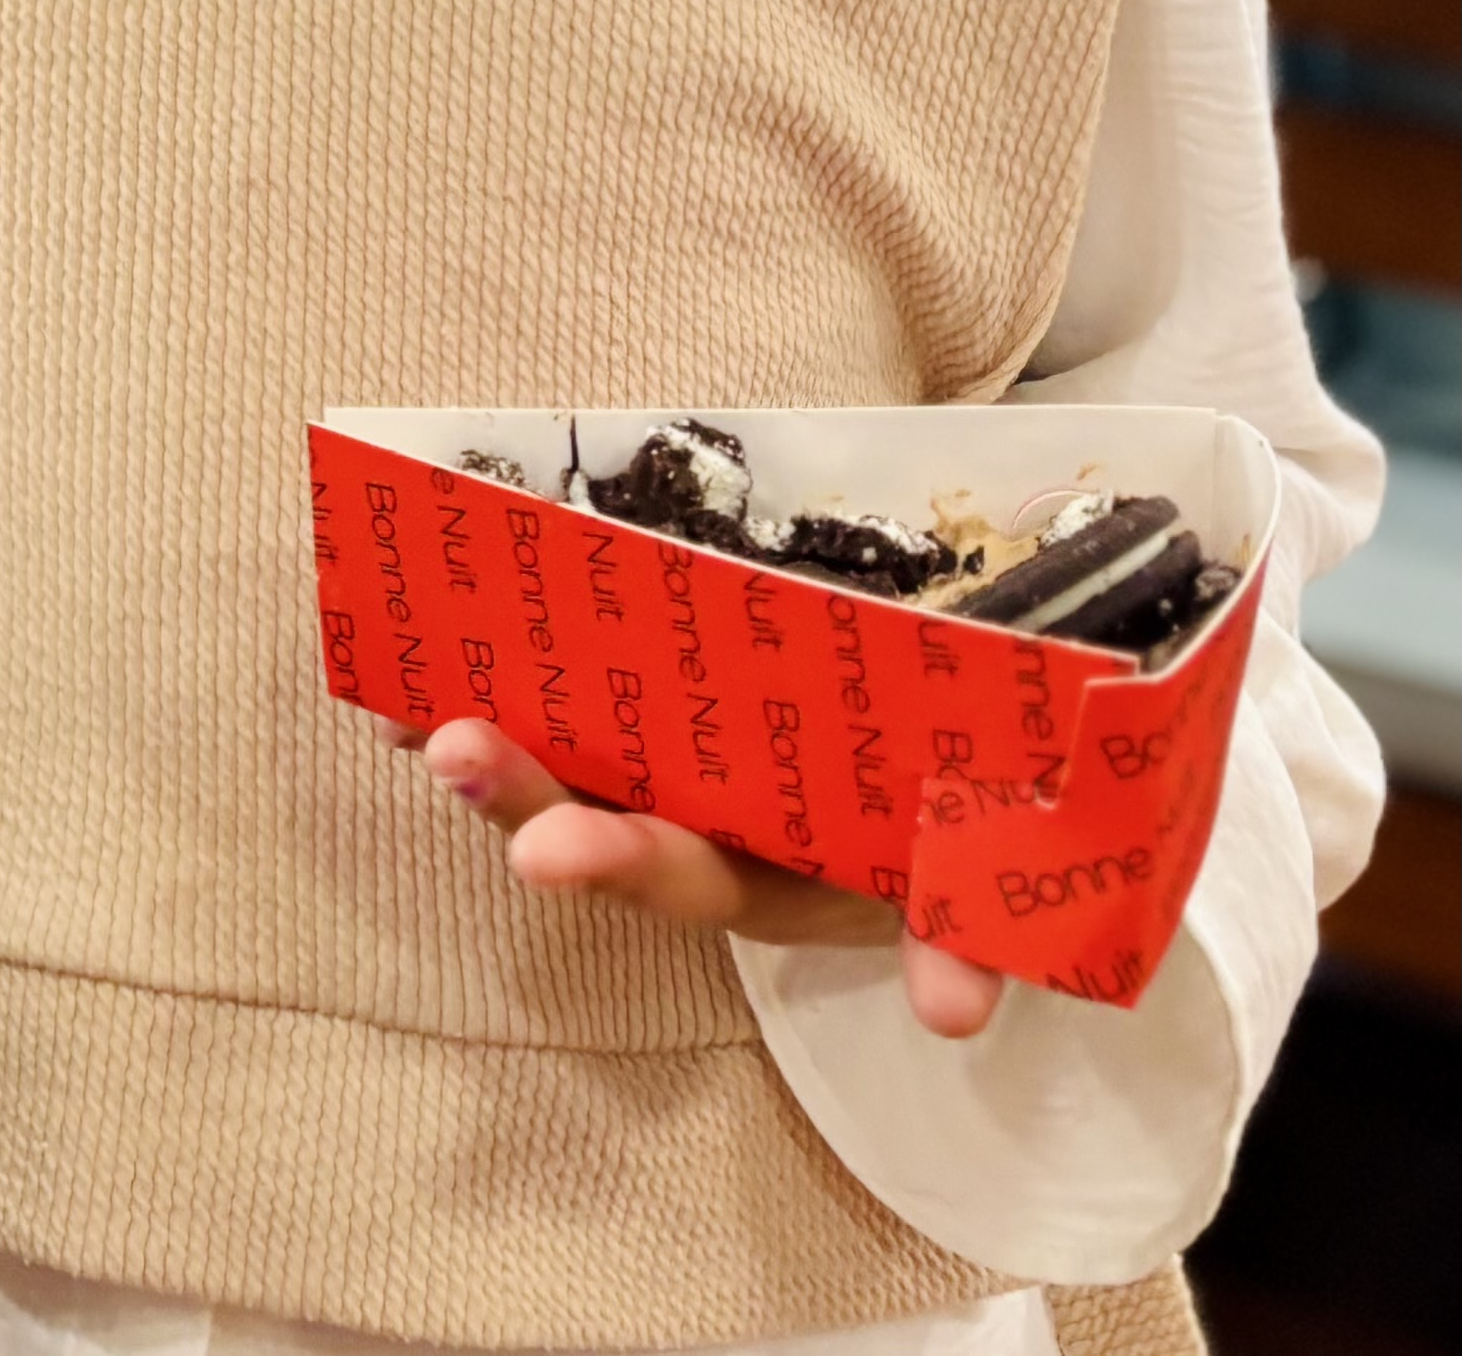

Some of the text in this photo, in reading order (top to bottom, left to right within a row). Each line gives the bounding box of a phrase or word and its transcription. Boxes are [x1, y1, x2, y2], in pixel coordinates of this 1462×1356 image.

[437, 504, 476, 593] Nuit
[583, 530, 624, 622] Nuit
[365, 481, 435, 719] Bonne Nuit
[506, 506, 577, 753] Bonne Nuit
[917, 619, 960, 680] uit
[461, 637, 499, 724] Bon
[658, 541, 707, 684] Bonne
[686, 693, 730, 786] Nuit
[826, 593, 871, 716] onne
[1013, 640, 1055, 741] nne
[607, 666, 656, 813] Bonne
[762, 697, 814, 848] Bonne
[847, 723, 895, 820] Nuit
[996, 846, 1154, 917] Bonne
